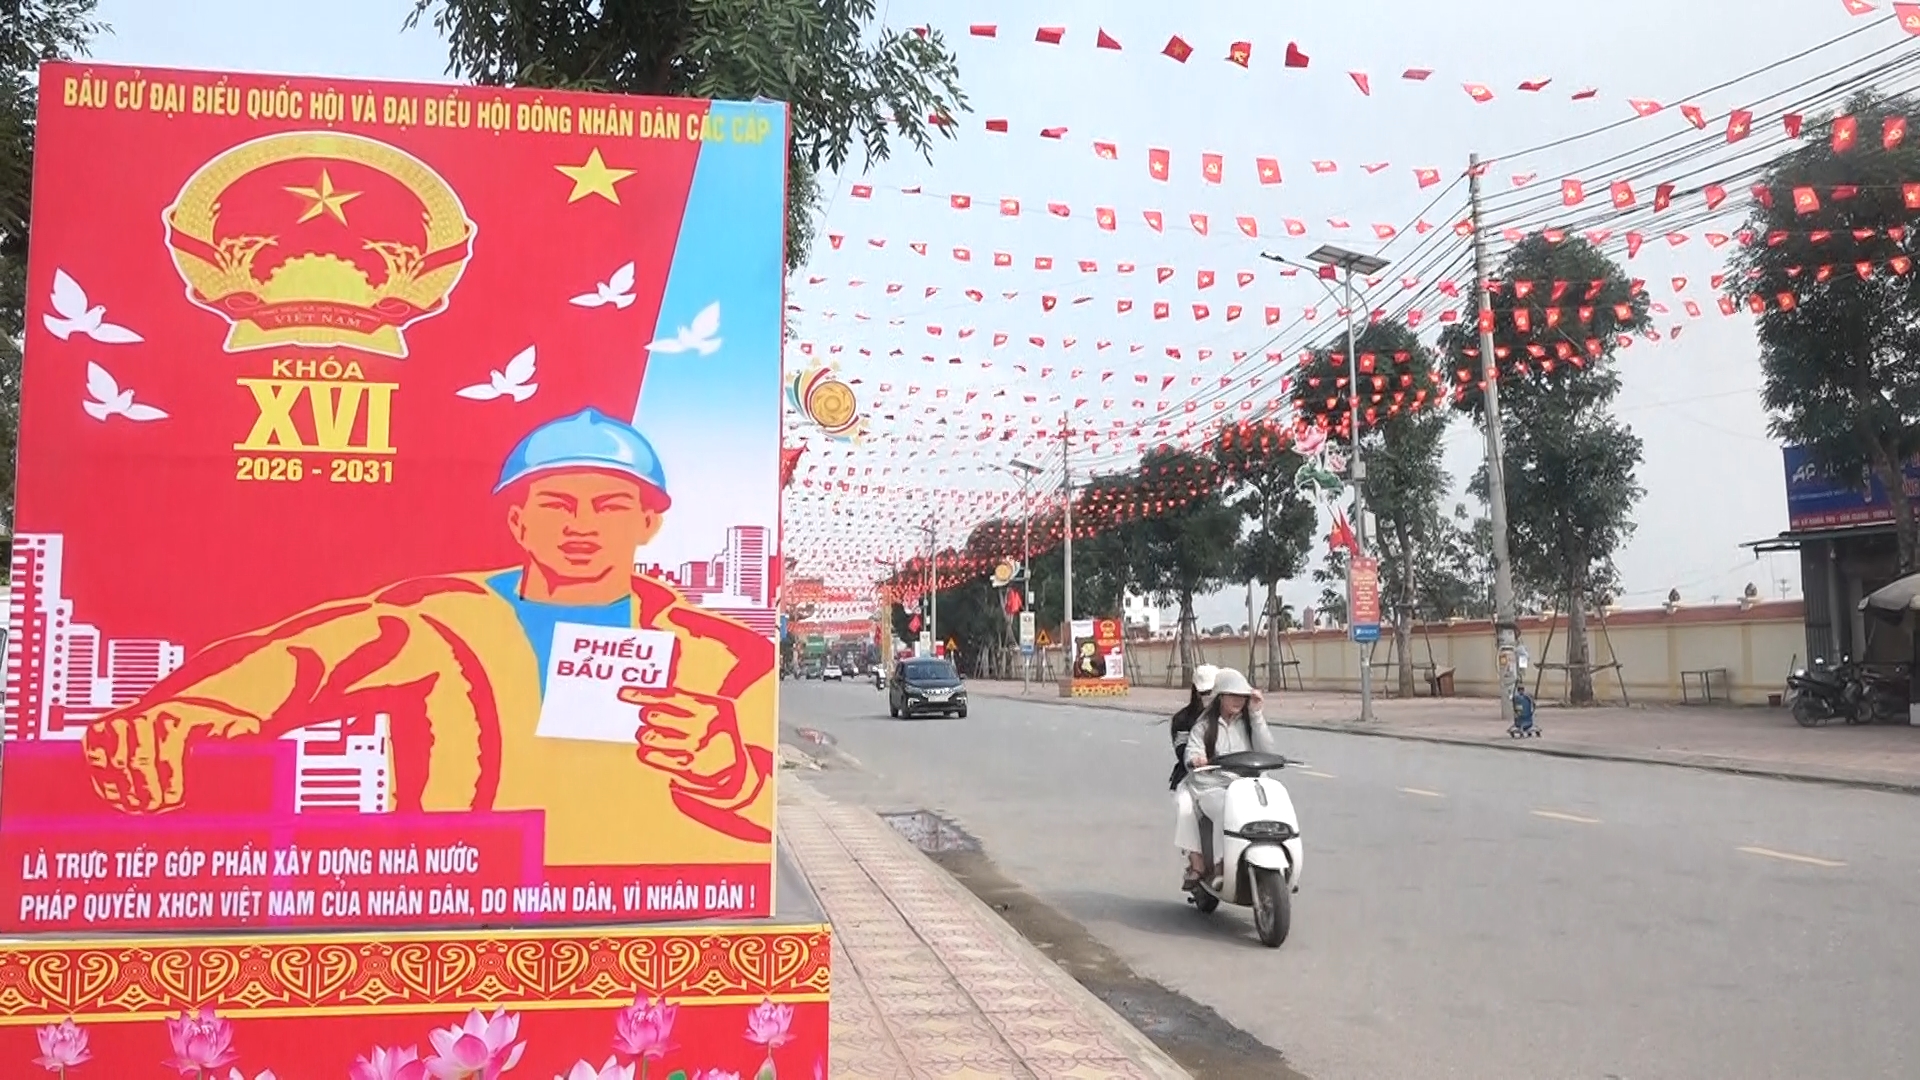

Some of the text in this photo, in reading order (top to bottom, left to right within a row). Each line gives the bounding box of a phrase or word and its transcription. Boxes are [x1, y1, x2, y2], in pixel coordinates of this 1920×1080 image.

[64, 69, 107, 108] BẦU
[115, 70, 146, 110] CỬ
[150, 82, 184, 119] ĐẠI
[192, 75, 240, 116] BIỂU
[247, 80, 302, 120] QUỐC
[310, 87, 344, 127] HỘI
[351, 89, 377, 123] VÀ
[384, 96, 417, 131] ĐẠI
[424, 88, 470, 129] BIỂU
[477, 96, 510, 136] HỘI
[517, 94, 571, 133] ĐỒNG
[578, 104, 634, 137] NHÂN
[640, 106, 680, 139] DÂN
[686, 110, 725, 142] CÁC
[321, 314, 361, 327] NAM
[272, 356, 365, 380] KHÓA
[233, 379, 399, 454] XVI
[236, 457, 303, 481] 2026
[330, 459, 393, 483] 2031
[573, 636, 653, 660] PHIẾU
[621, 663, 662, 684] CỬ
[22, 840, 479, 884] LÀ TRỰC TIẾP GÓP PHẦN XÂY DỰNG NHÀ NƯỚC
[20, 879, 755, 922] PHÁP QUYỀN XHCN VIỆT NAM CỦA NHÂN DÂN, DO NHÂN DÂN, VÌ NHÂN DÂN !
